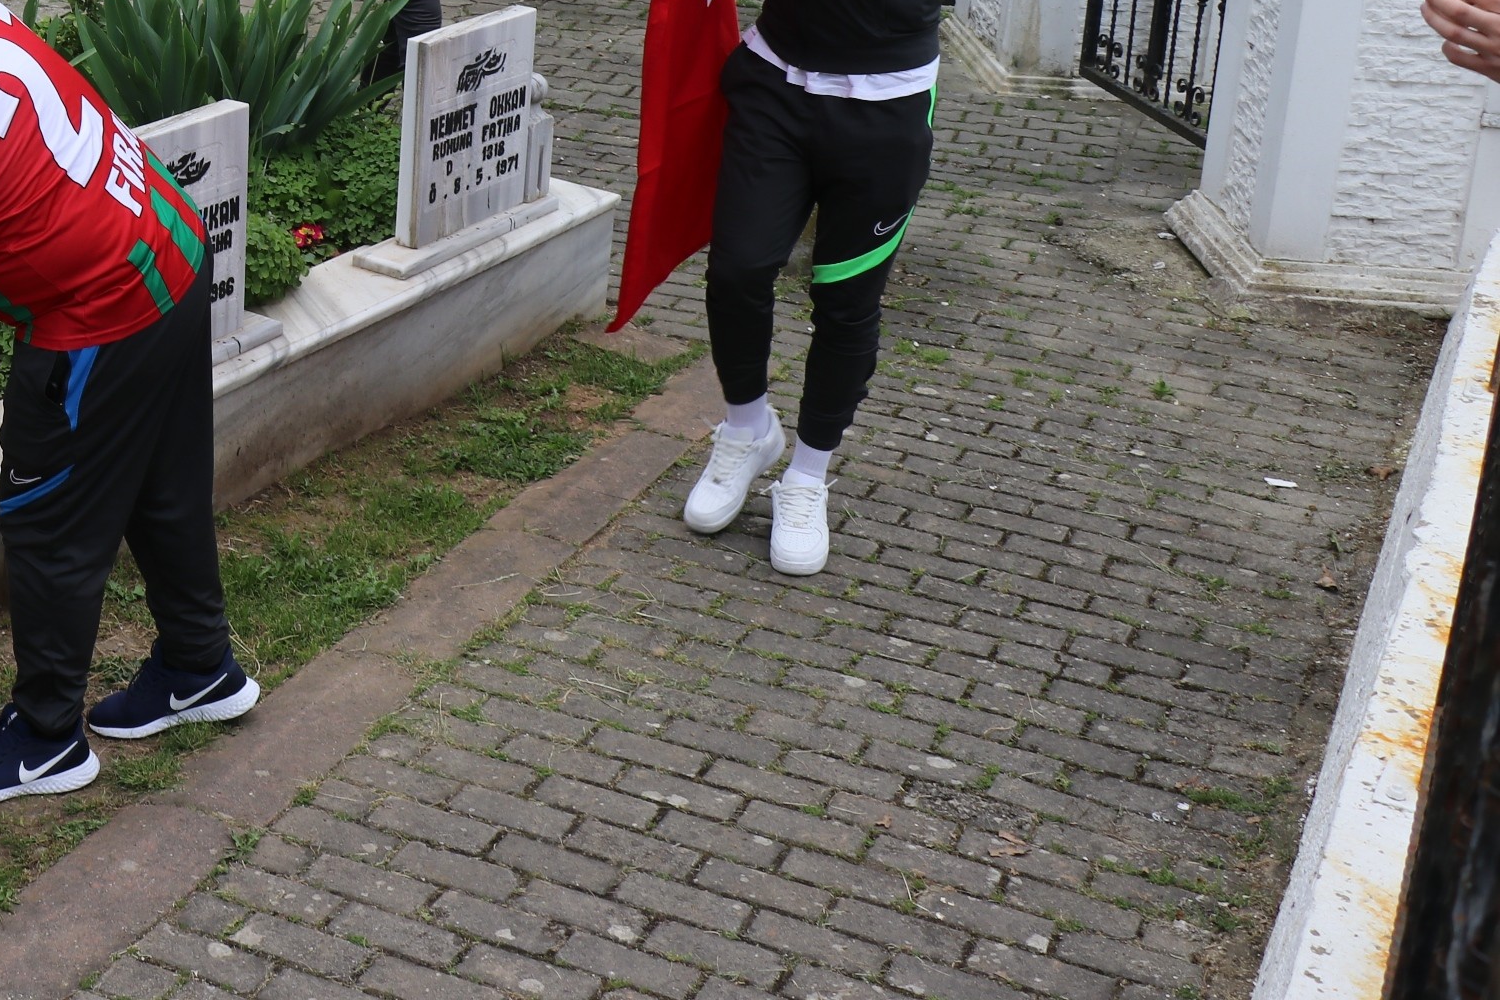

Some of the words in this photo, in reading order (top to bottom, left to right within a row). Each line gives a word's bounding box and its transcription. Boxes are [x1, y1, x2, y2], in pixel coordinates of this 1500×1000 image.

[488, 84, 527, 119] OKKAN
[104, 106, 147, 218] FIRA
[432, 131, 473, 162] RUHUNA
[200, 195, 240, 231] KKAN
[210, 277, 235, 303] 986
